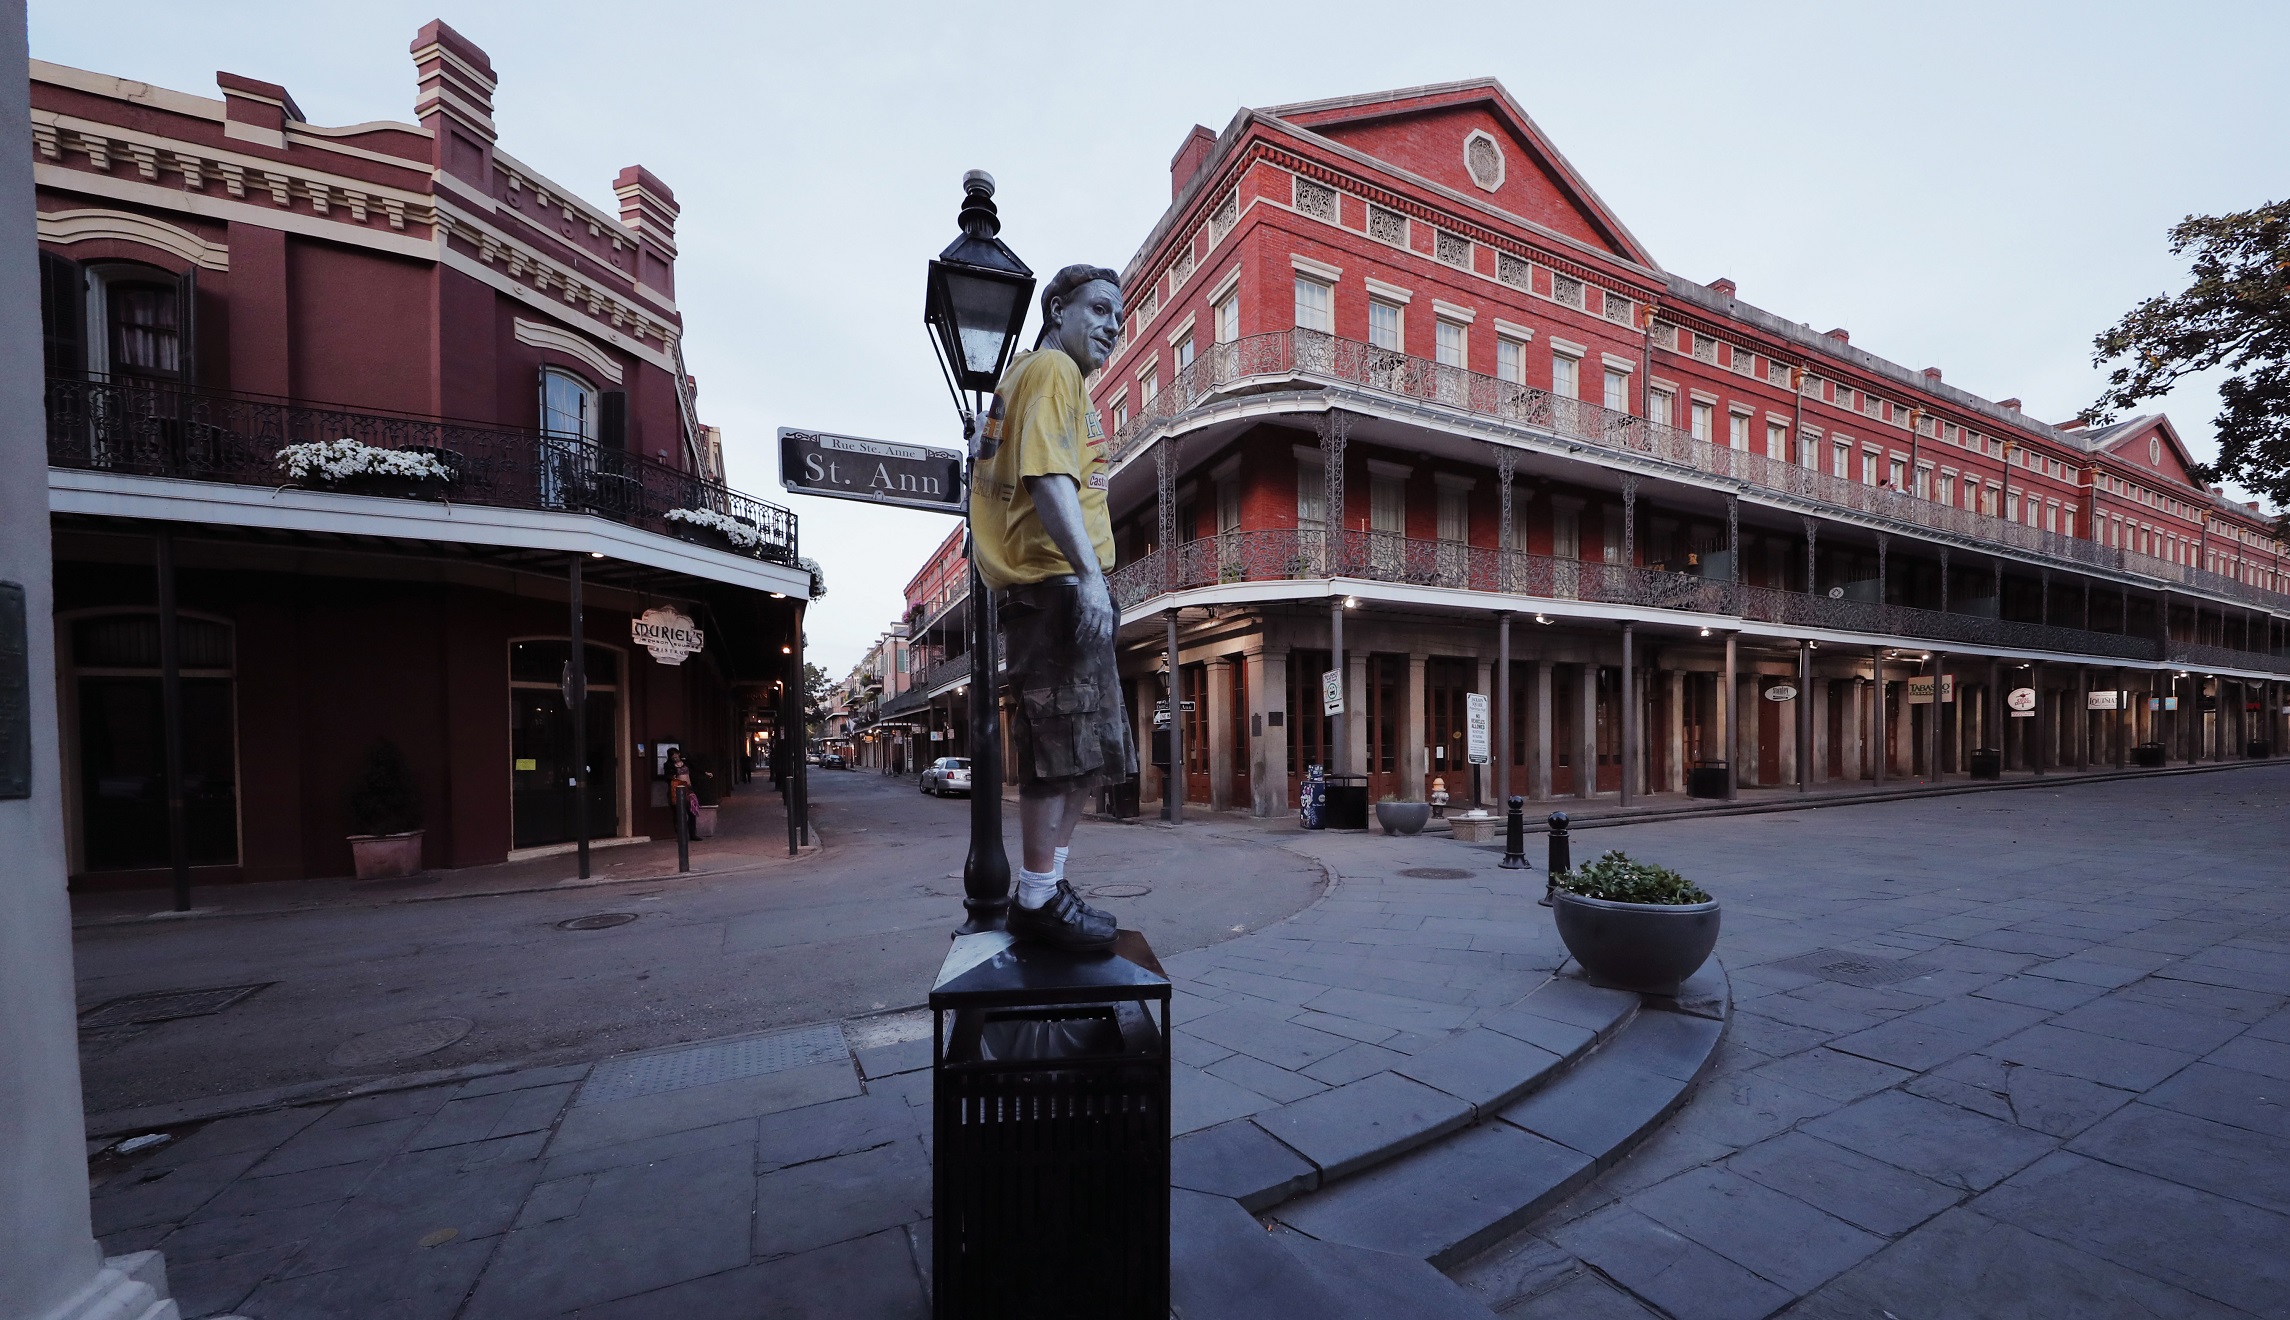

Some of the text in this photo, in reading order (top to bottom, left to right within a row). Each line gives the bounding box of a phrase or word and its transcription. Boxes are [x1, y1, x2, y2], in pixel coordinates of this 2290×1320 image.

[832, 438, 916, 458] Rue Ste. Anne
[805, 453, 851, 485] St.
[869, 462, 941, 495] Ann
[635, 622, 703, 648] MURIEL'S
[1910, 683, 1950, 691] TABASO
[2089, 697, 2117, 706] LOUISIA
